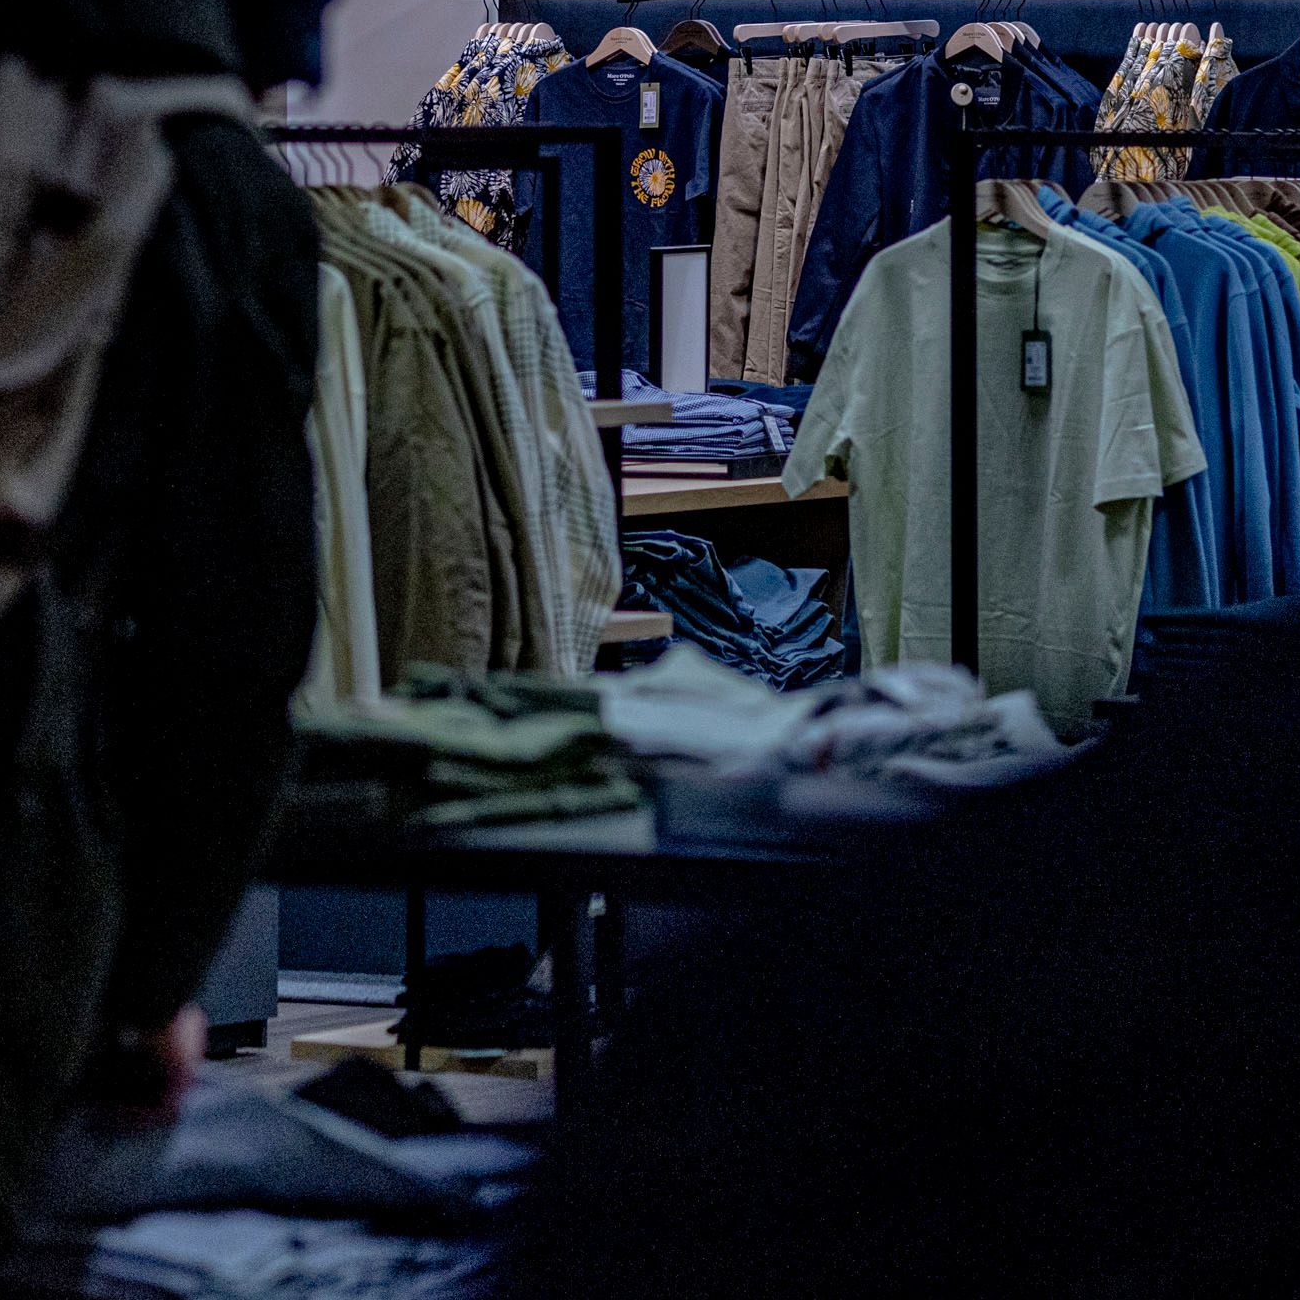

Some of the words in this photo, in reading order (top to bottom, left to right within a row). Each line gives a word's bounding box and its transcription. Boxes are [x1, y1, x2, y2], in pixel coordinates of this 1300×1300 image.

[630, 147, 656, 177] GROW
[658, 148, 676, 179] WITH
[630, 178, 649, 204] THE
[650, 180, 676, 208] FLOW
